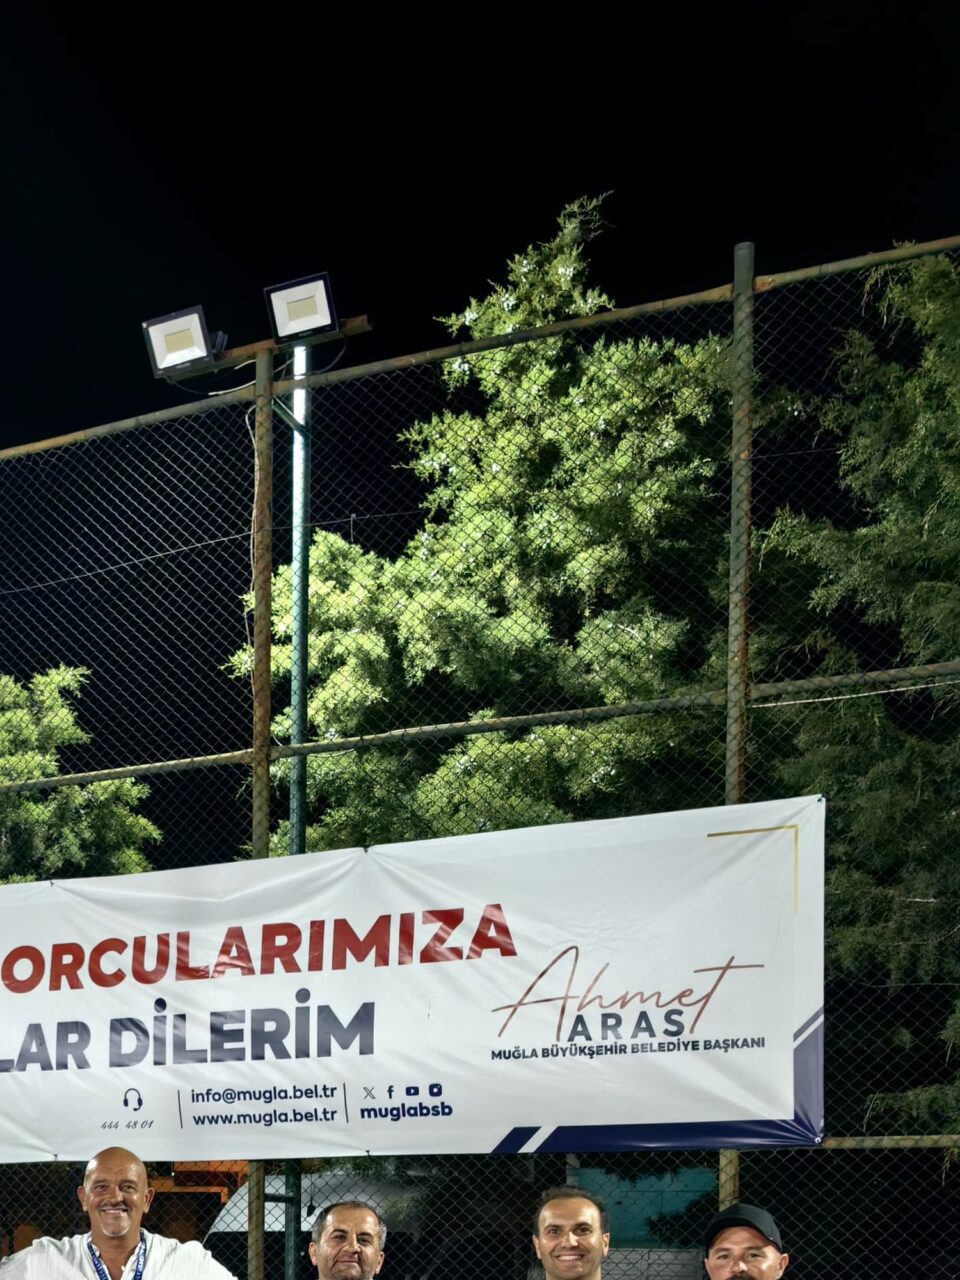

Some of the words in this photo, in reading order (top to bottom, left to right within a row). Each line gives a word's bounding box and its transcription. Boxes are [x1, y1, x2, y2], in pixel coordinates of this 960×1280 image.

[491, 945, 765, 1042] Ahmet
[109, 988, 375, 1068] DİLERİM
[567, 1009, 685, 1042] ARAS
[491, 1046, 538, 1060] MUĞLA
[541, 1041, 627, 1059] BÜYÜKŞEHİR
[631, 1038, 700, 1054] BELEDİYE
[703, 1037, 766, 1053] BAŞKANI
[191, 1084, 338, 1104] info@mugla.bel.tr
[192, 1108, 338, 1127] www.mugla.bel.tr
[360, 1101, 453, 1122] muglabsb
